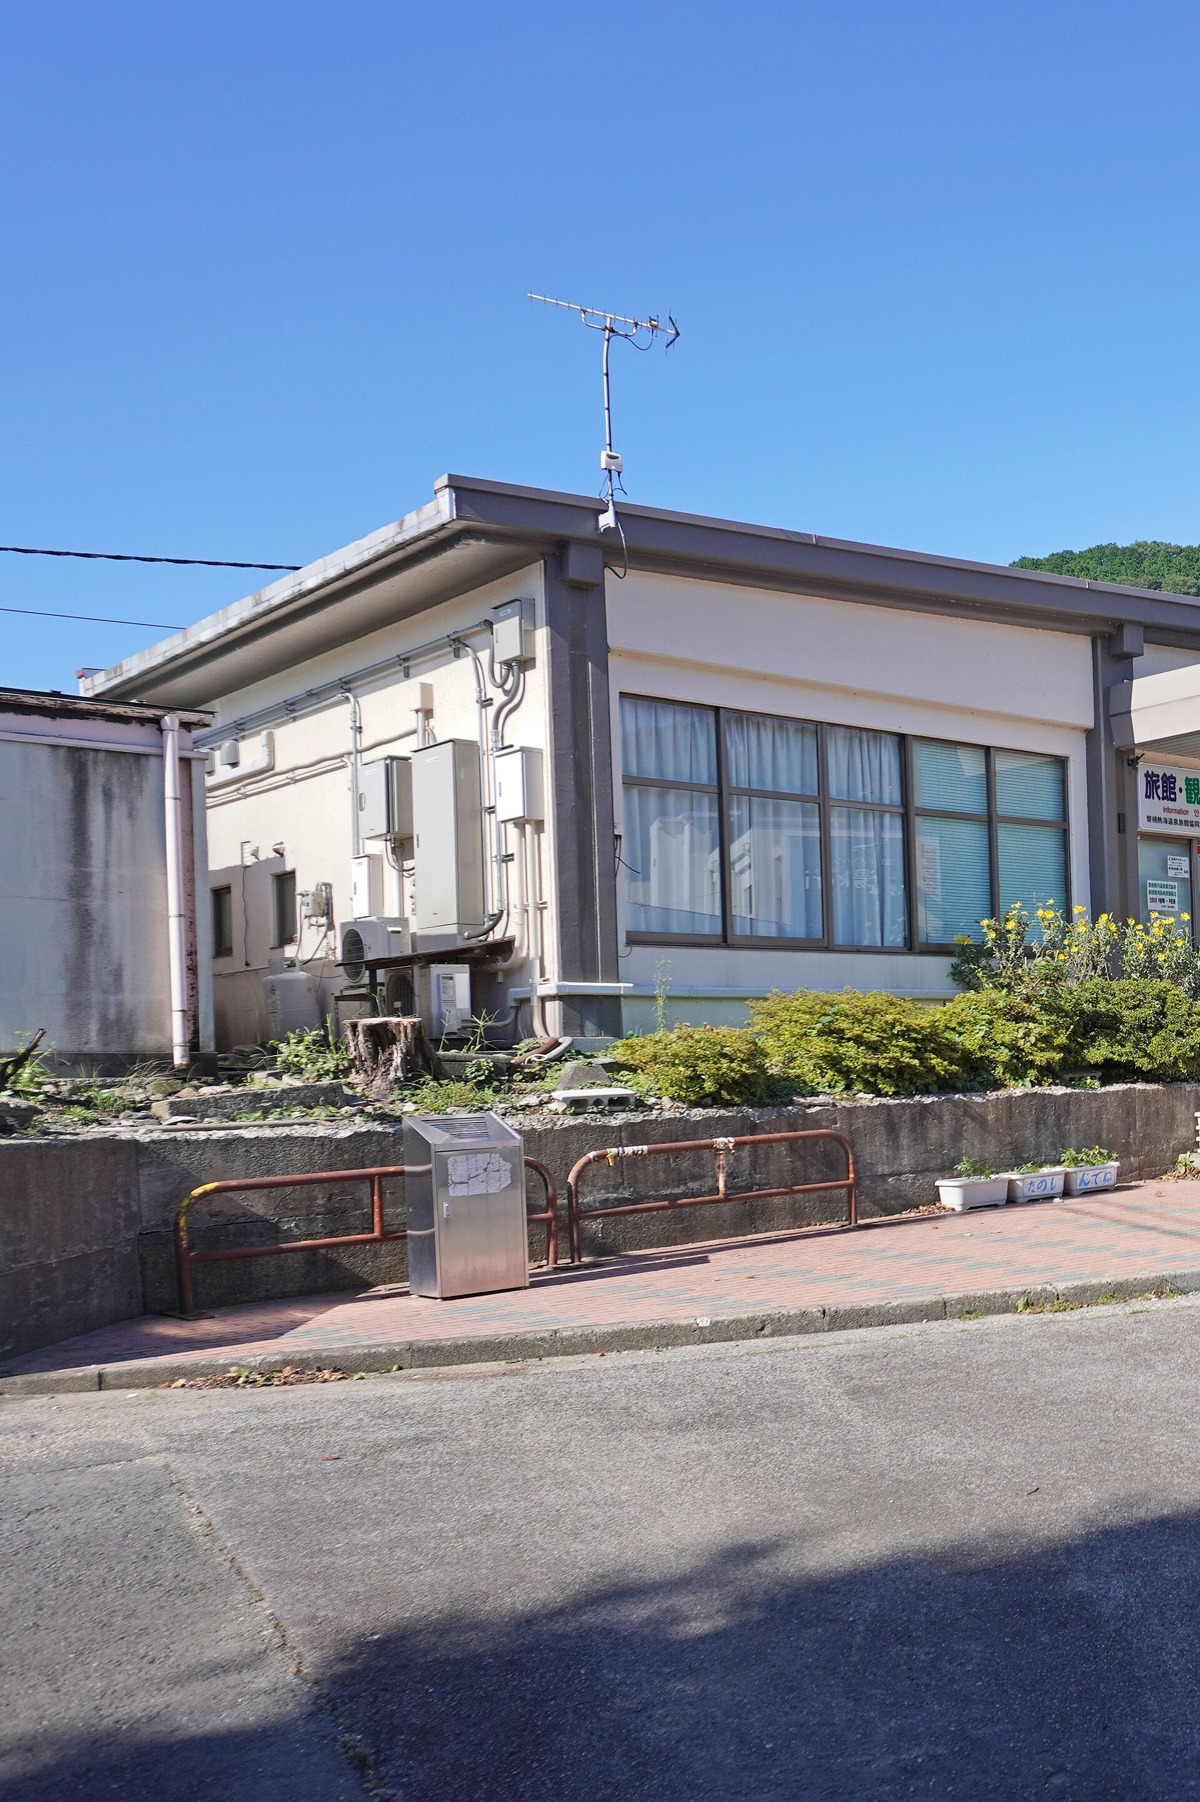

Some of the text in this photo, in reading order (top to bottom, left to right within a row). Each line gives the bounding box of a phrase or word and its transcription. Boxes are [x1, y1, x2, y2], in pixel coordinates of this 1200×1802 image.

[1162, 805, 1189, 816] Information
[1026, 1177, 1057, 1193] たのし
